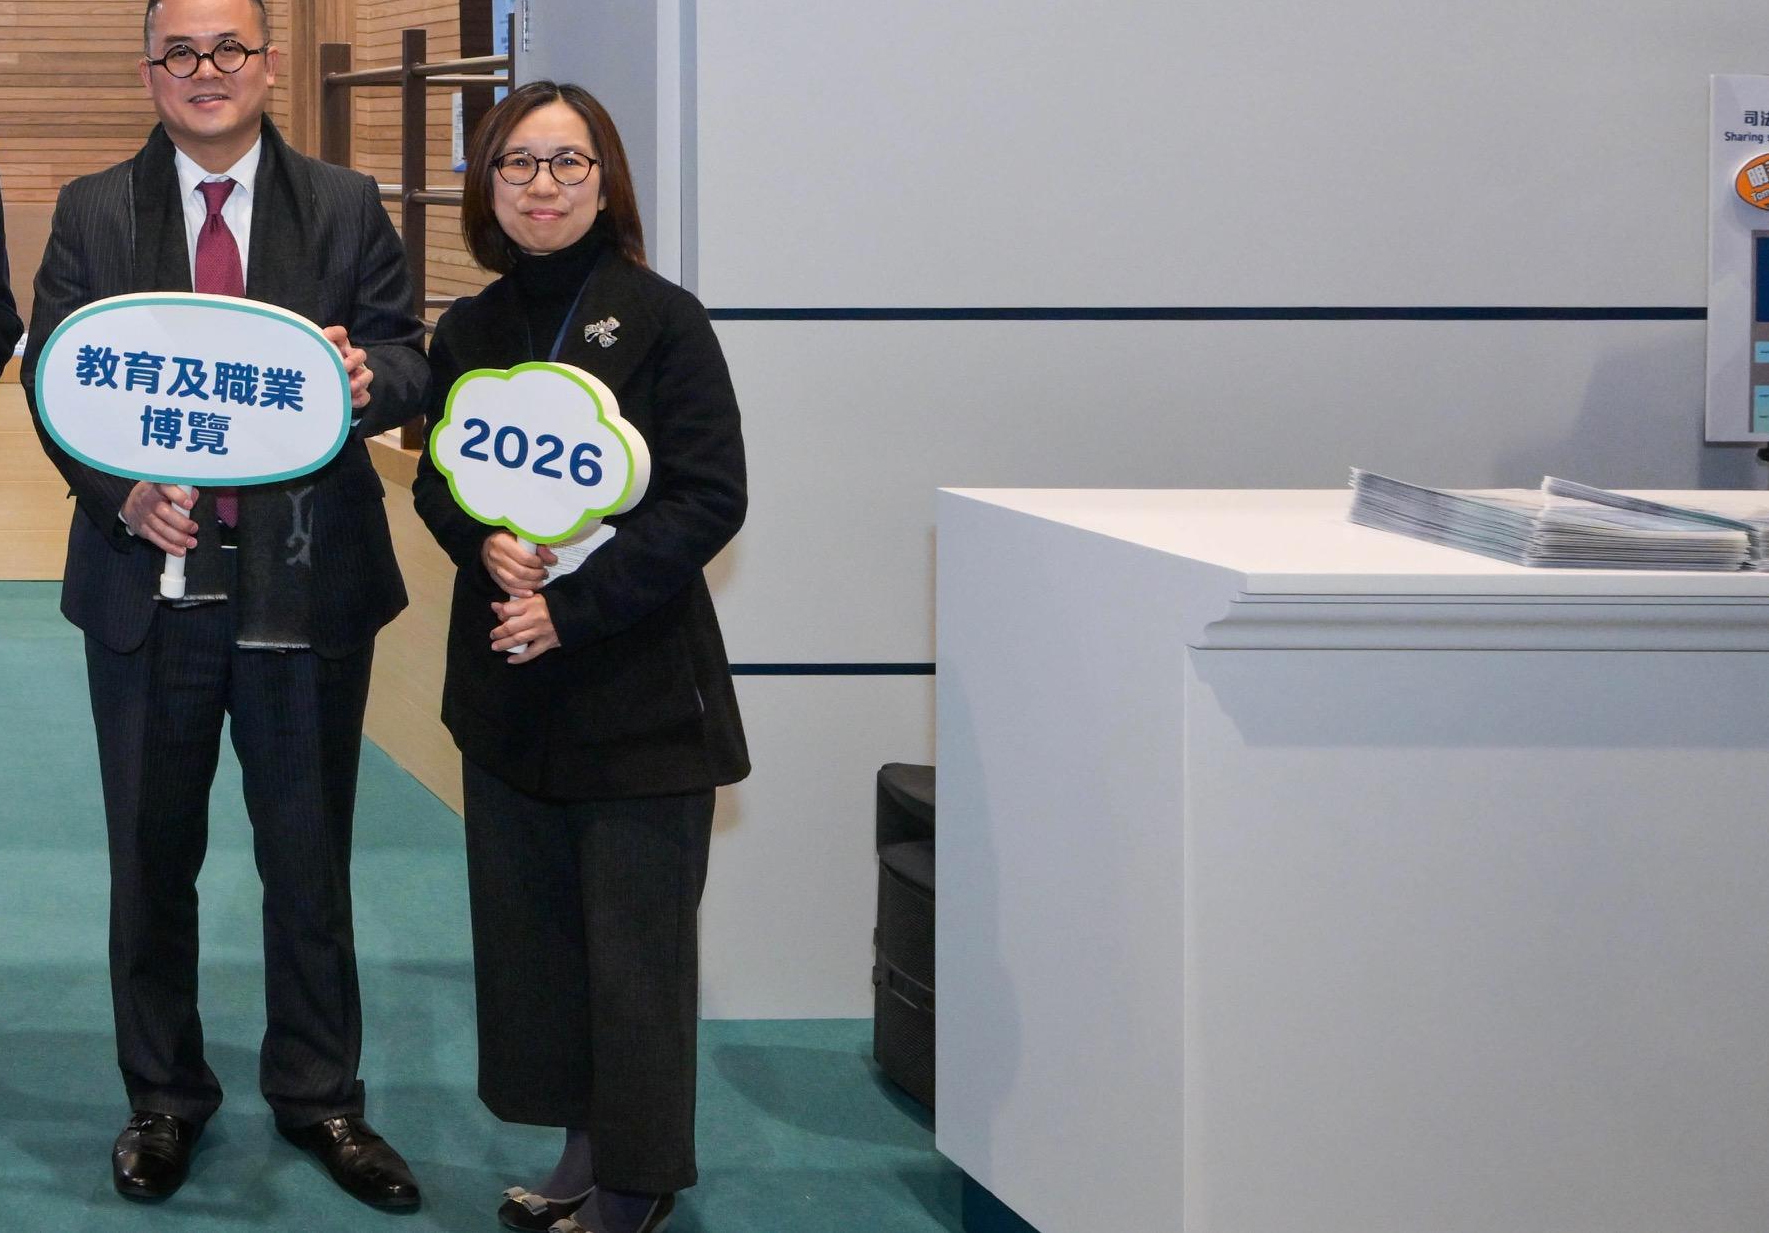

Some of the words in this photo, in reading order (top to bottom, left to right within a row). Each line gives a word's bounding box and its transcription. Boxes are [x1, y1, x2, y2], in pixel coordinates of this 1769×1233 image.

[1724, 132, 1764, 144] Sharing
[75, 344, 306, 413] 教育及職業
[140, 405, 230, 457] 博覽
[459, 417, 604, 488] 2026
